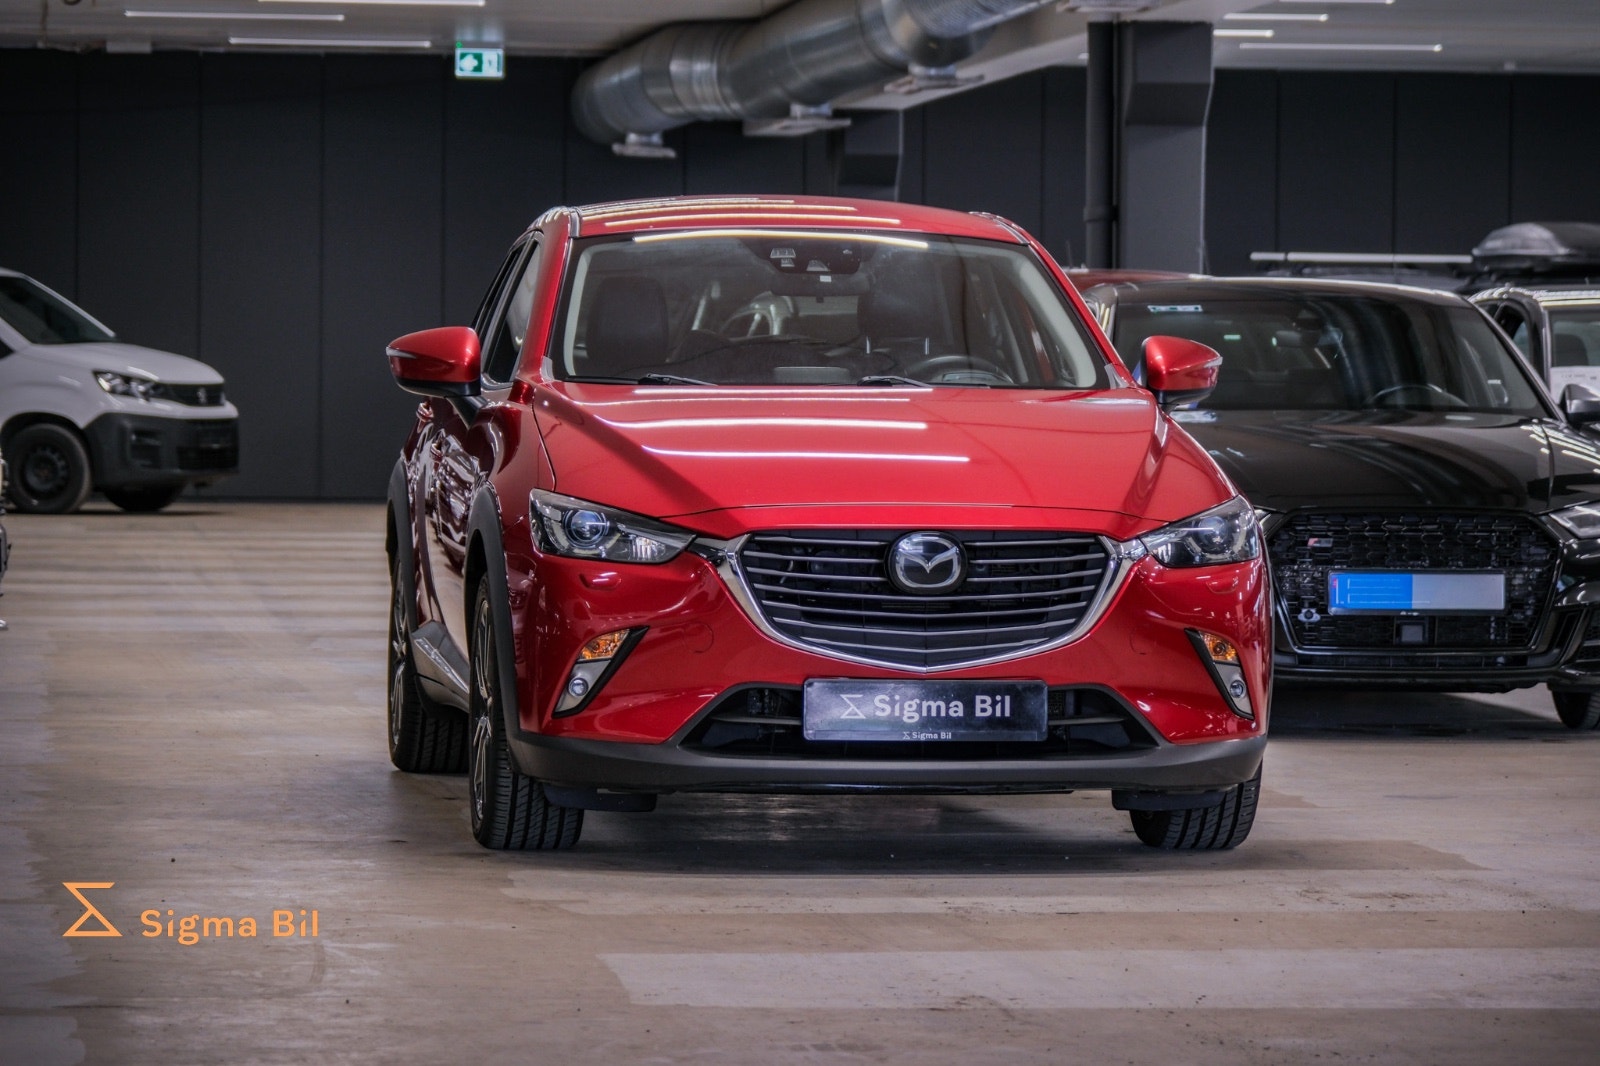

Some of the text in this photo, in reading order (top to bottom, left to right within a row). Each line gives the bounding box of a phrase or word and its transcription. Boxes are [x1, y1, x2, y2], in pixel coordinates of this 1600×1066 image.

[873, 694, 1011, 723] Sigma Bil
[911, 731, 952, 740] Sigma Bil
